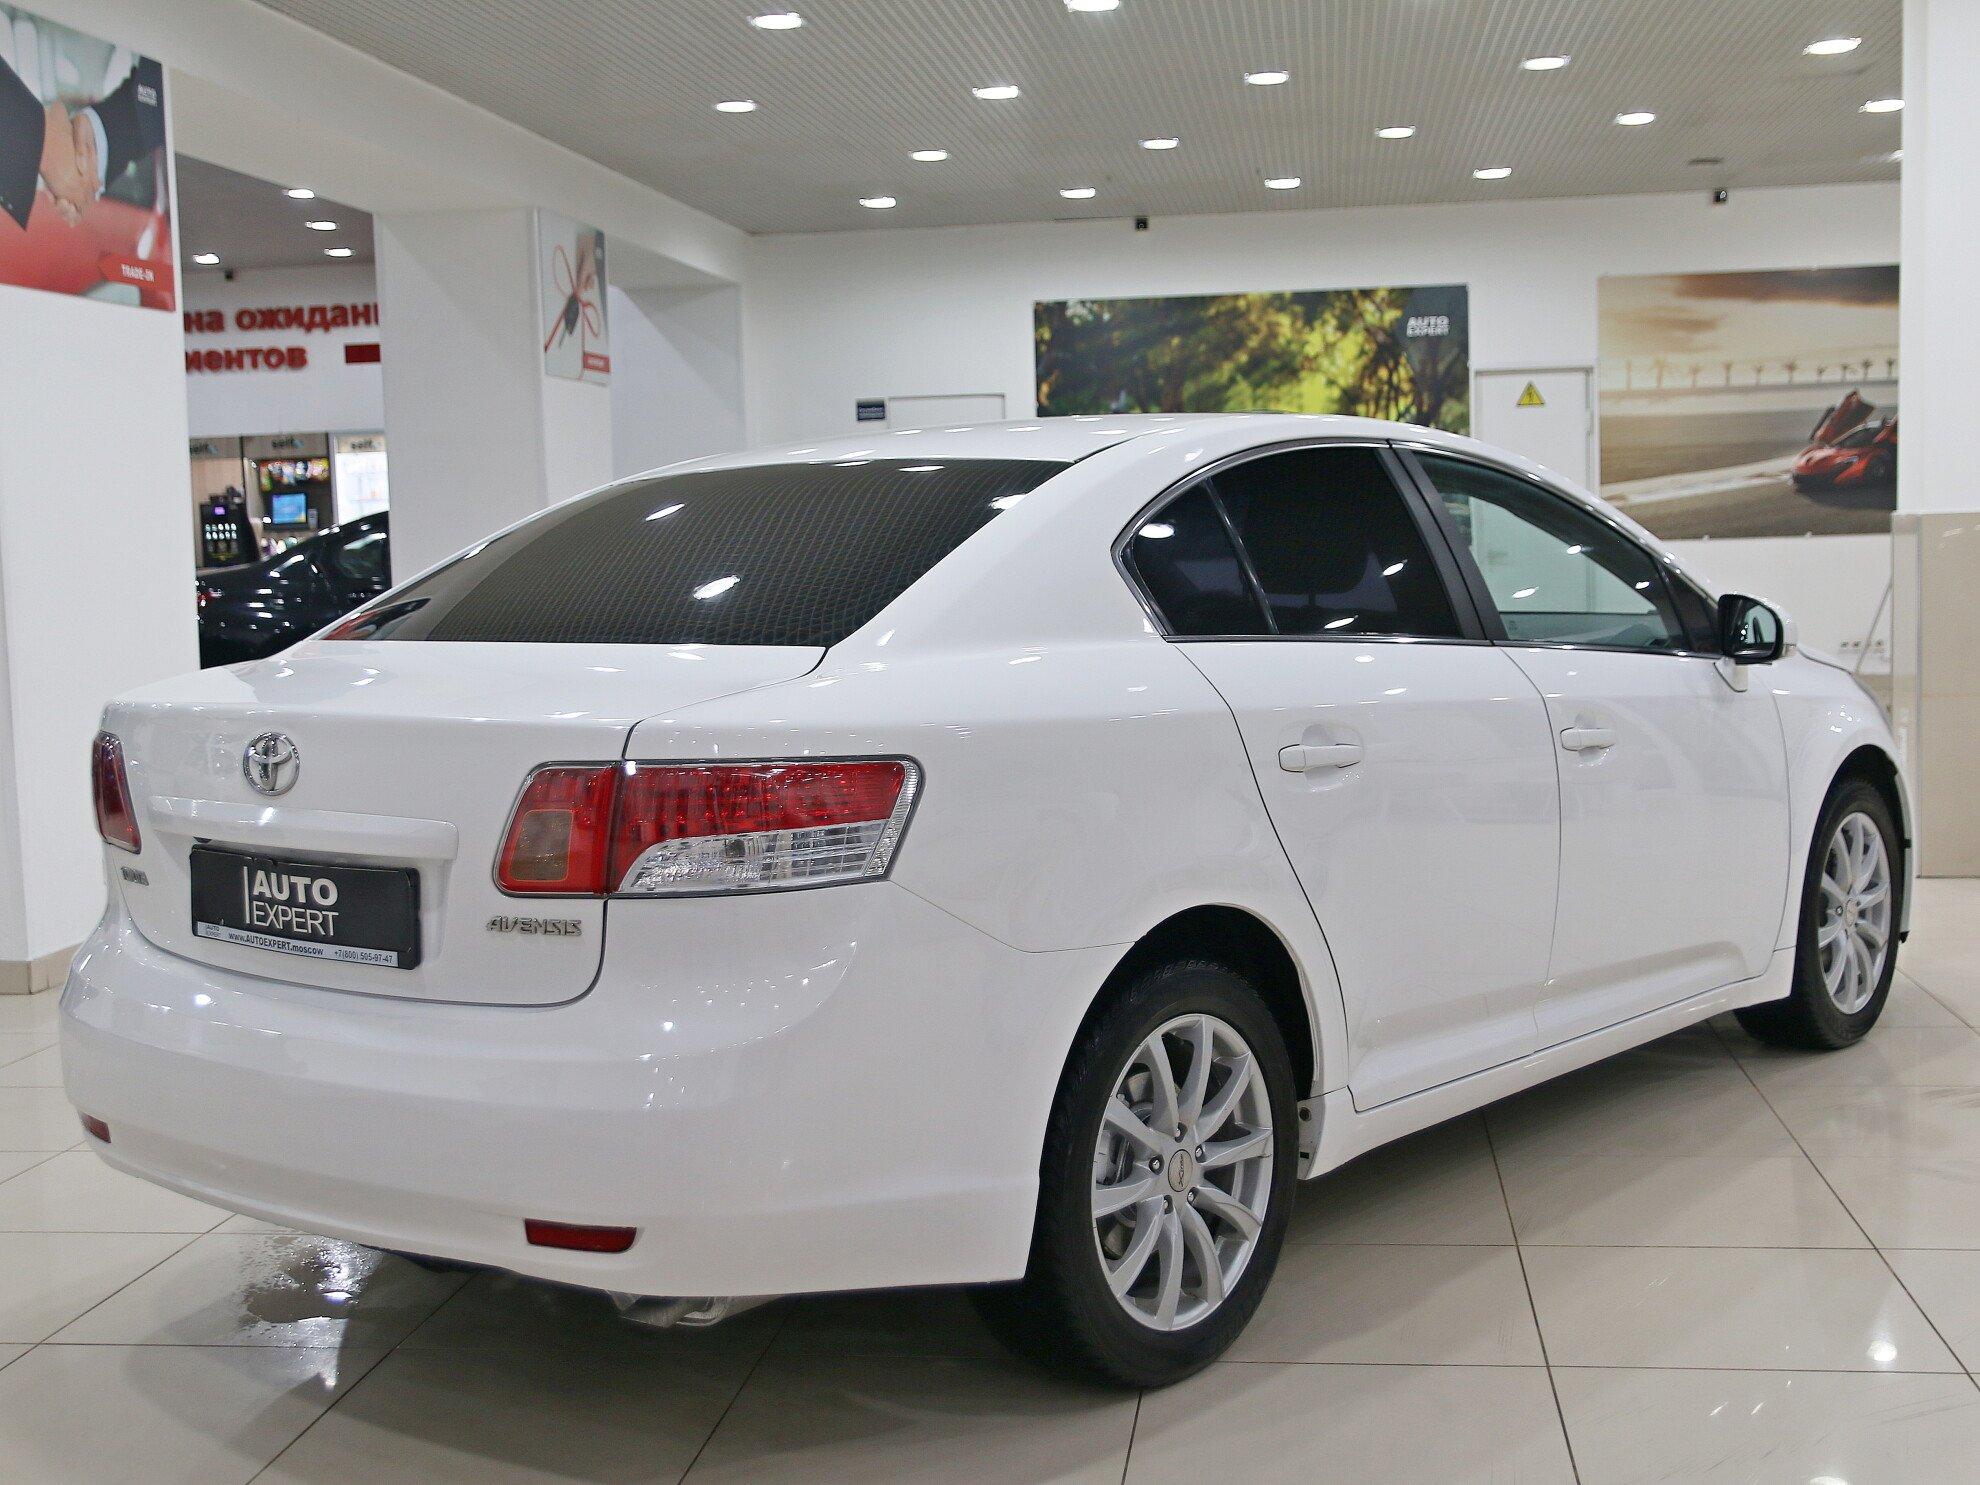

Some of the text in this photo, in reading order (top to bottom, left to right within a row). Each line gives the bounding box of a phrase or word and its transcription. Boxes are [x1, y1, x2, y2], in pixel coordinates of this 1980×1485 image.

[1407, 324, 1450, 338] EXPERT
[1408, 315, 1451, 326] AUTO
[252, 869, 339, 907] AUTO
[252, 901, 340, 937] EXPERT
[485, 915, 582, 936] AVENSIS
[228, 932, 324, 955] www.AUTOEXPERT.moscow
